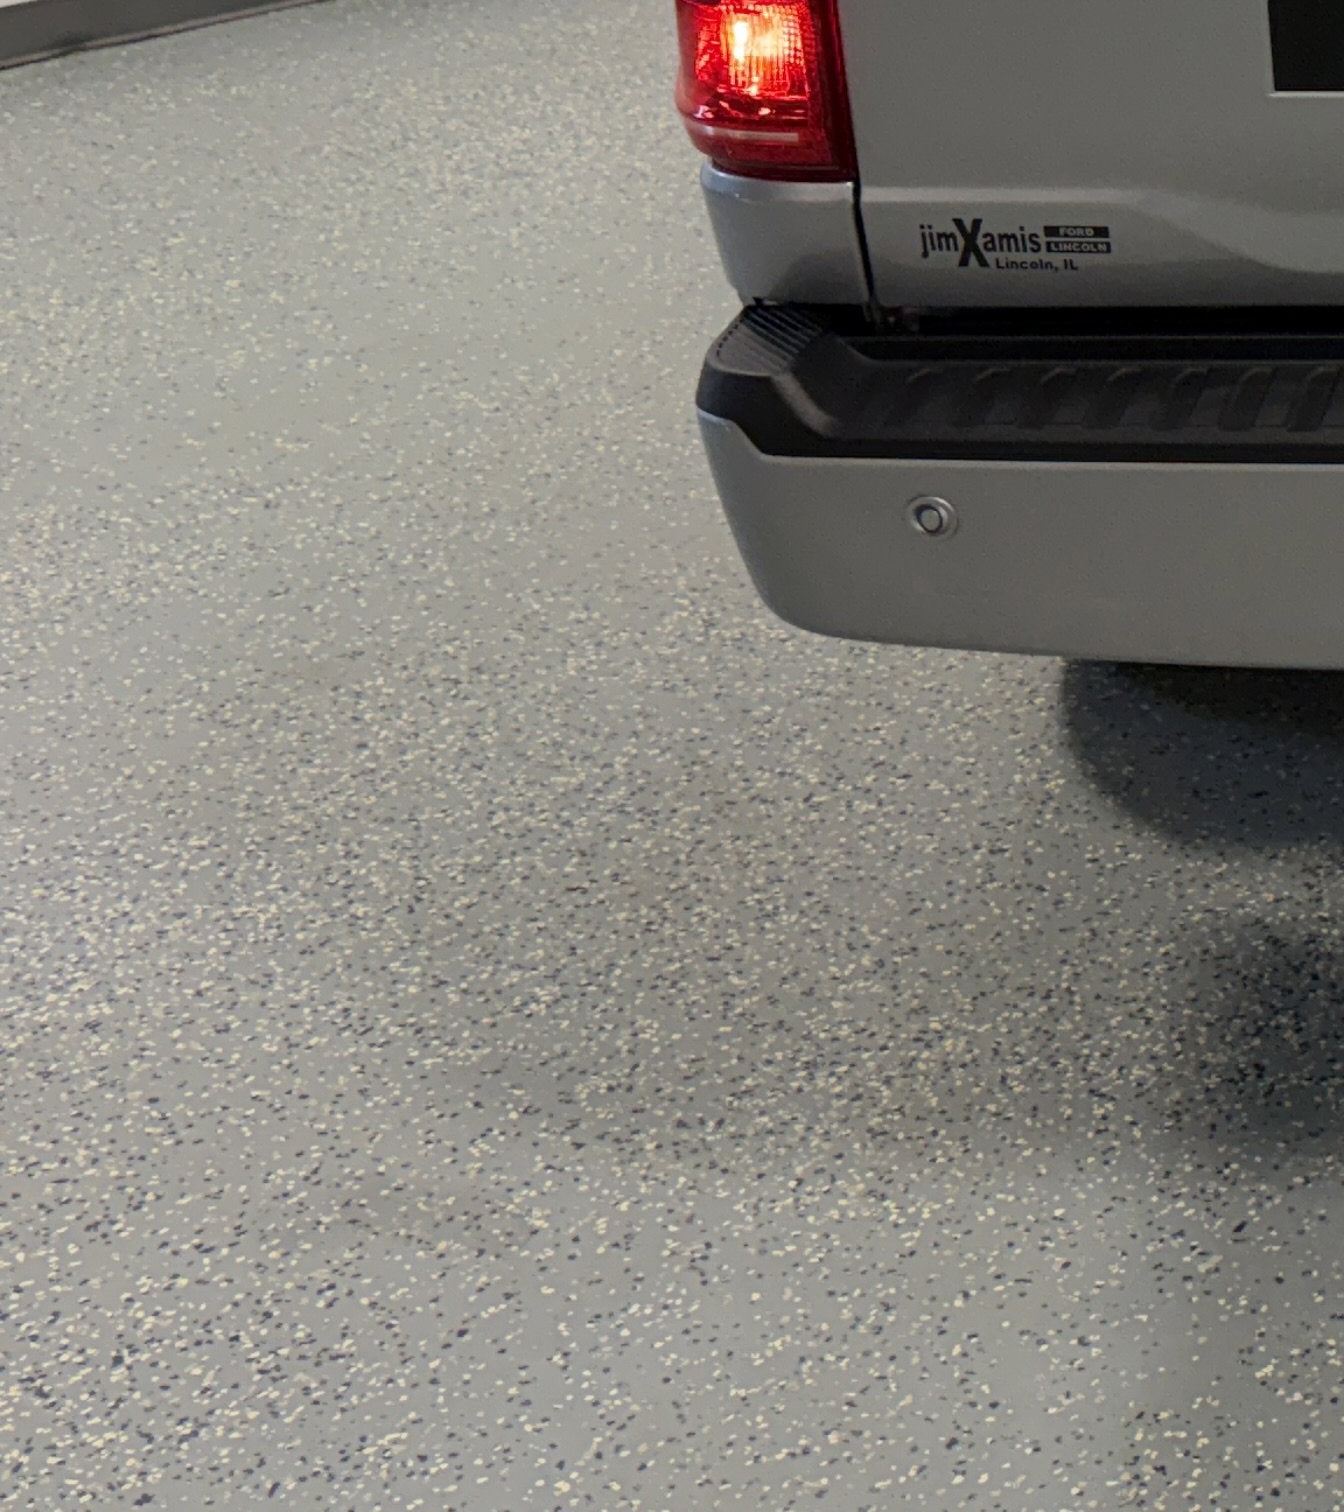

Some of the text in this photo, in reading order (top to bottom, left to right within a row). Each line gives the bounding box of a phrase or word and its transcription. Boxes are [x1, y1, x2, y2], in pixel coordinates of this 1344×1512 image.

[1058, 226, 1096, 238] FORD
[1050, 241, 1108, 253] LINCOLN
[996, 258, 1079, 272] Lincoln, IL
